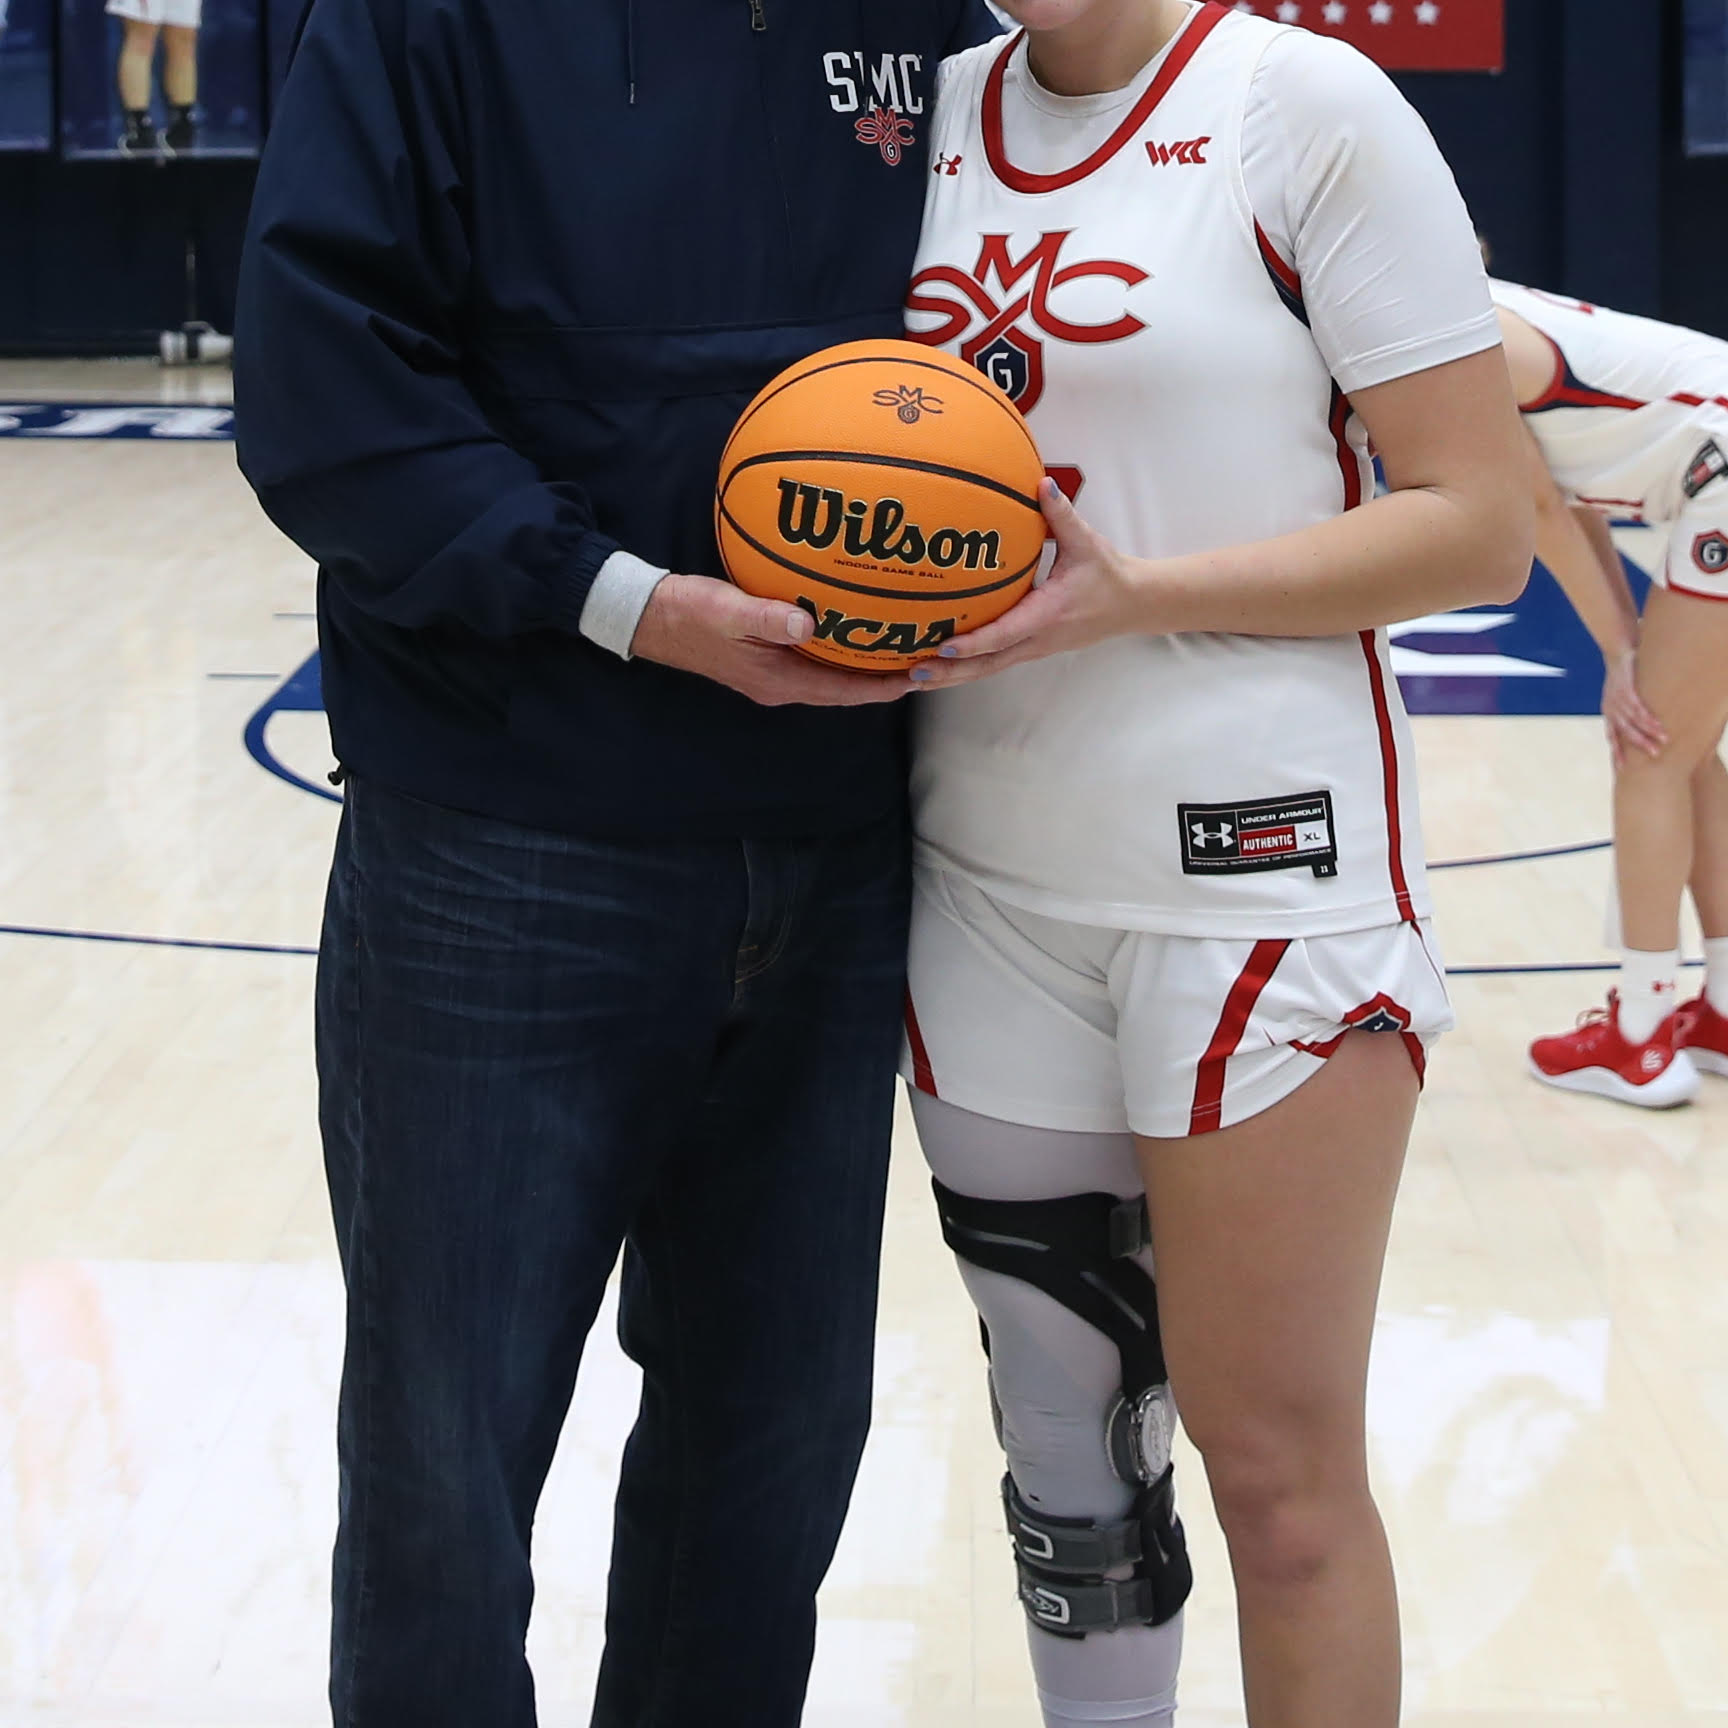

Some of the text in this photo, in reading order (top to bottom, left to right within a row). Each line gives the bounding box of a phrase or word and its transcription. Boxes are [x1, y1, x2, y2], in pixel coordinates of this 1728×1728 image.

[1143, 135, 1213, 168] WCC
[903, 226, 1156, 348] SMC
[985, 351, 1015, 393] G
[871, 384, 945, 415] SMC
[776, 477, 1001, 571] Wilson
[832, 558, 946, 580] INDOOR GAME BALL
[795, 594, 957, 655] NCAA
[1240, 807, 1324, 825] UNDER ARMOUR
[1242, 832, 1322, 852] AUTHENTIC XL
